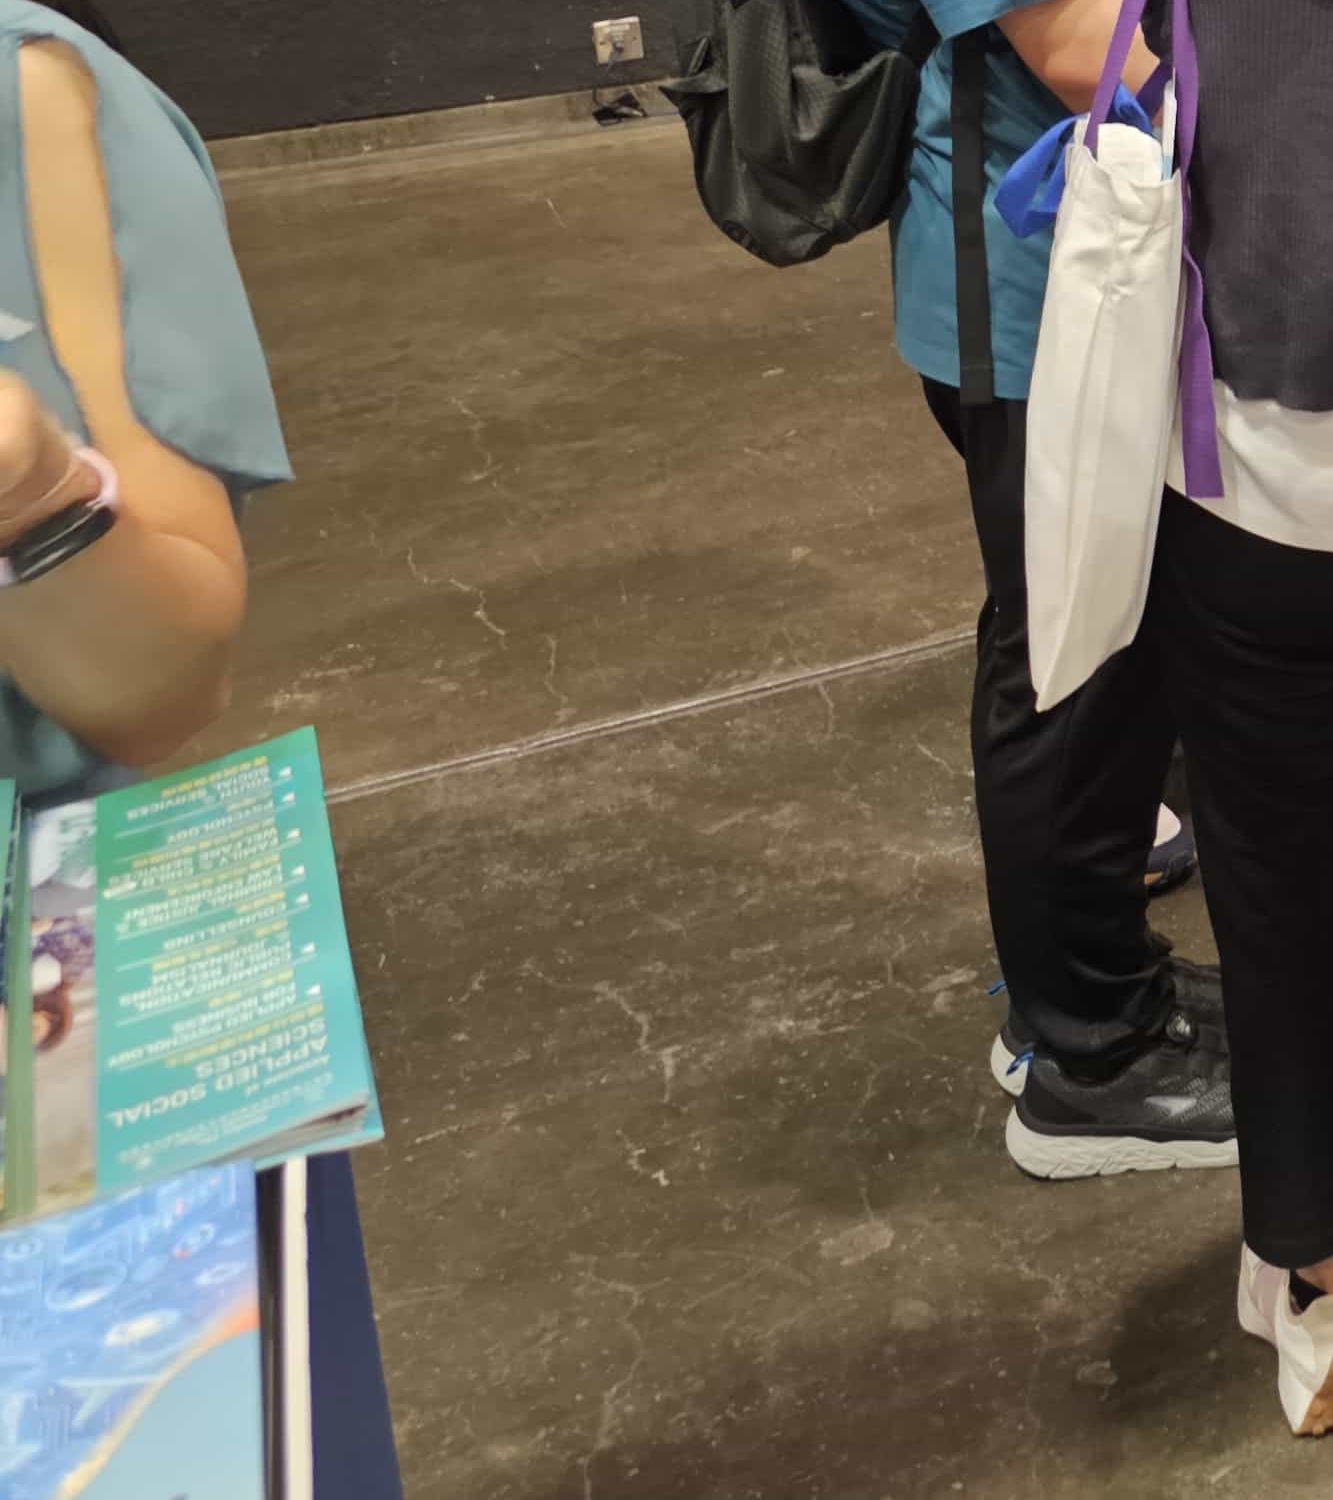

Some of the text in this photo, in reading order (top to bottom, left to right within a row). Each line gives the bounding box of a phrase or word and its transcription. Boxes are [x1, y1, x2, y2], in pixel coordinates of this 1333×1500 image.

[162, 903, 287, 950] COUNSELLING
[194, 1022, 326, 1074] SCIENCES
[105, 1039, 329, 1129] APPLIED SOCIAL
